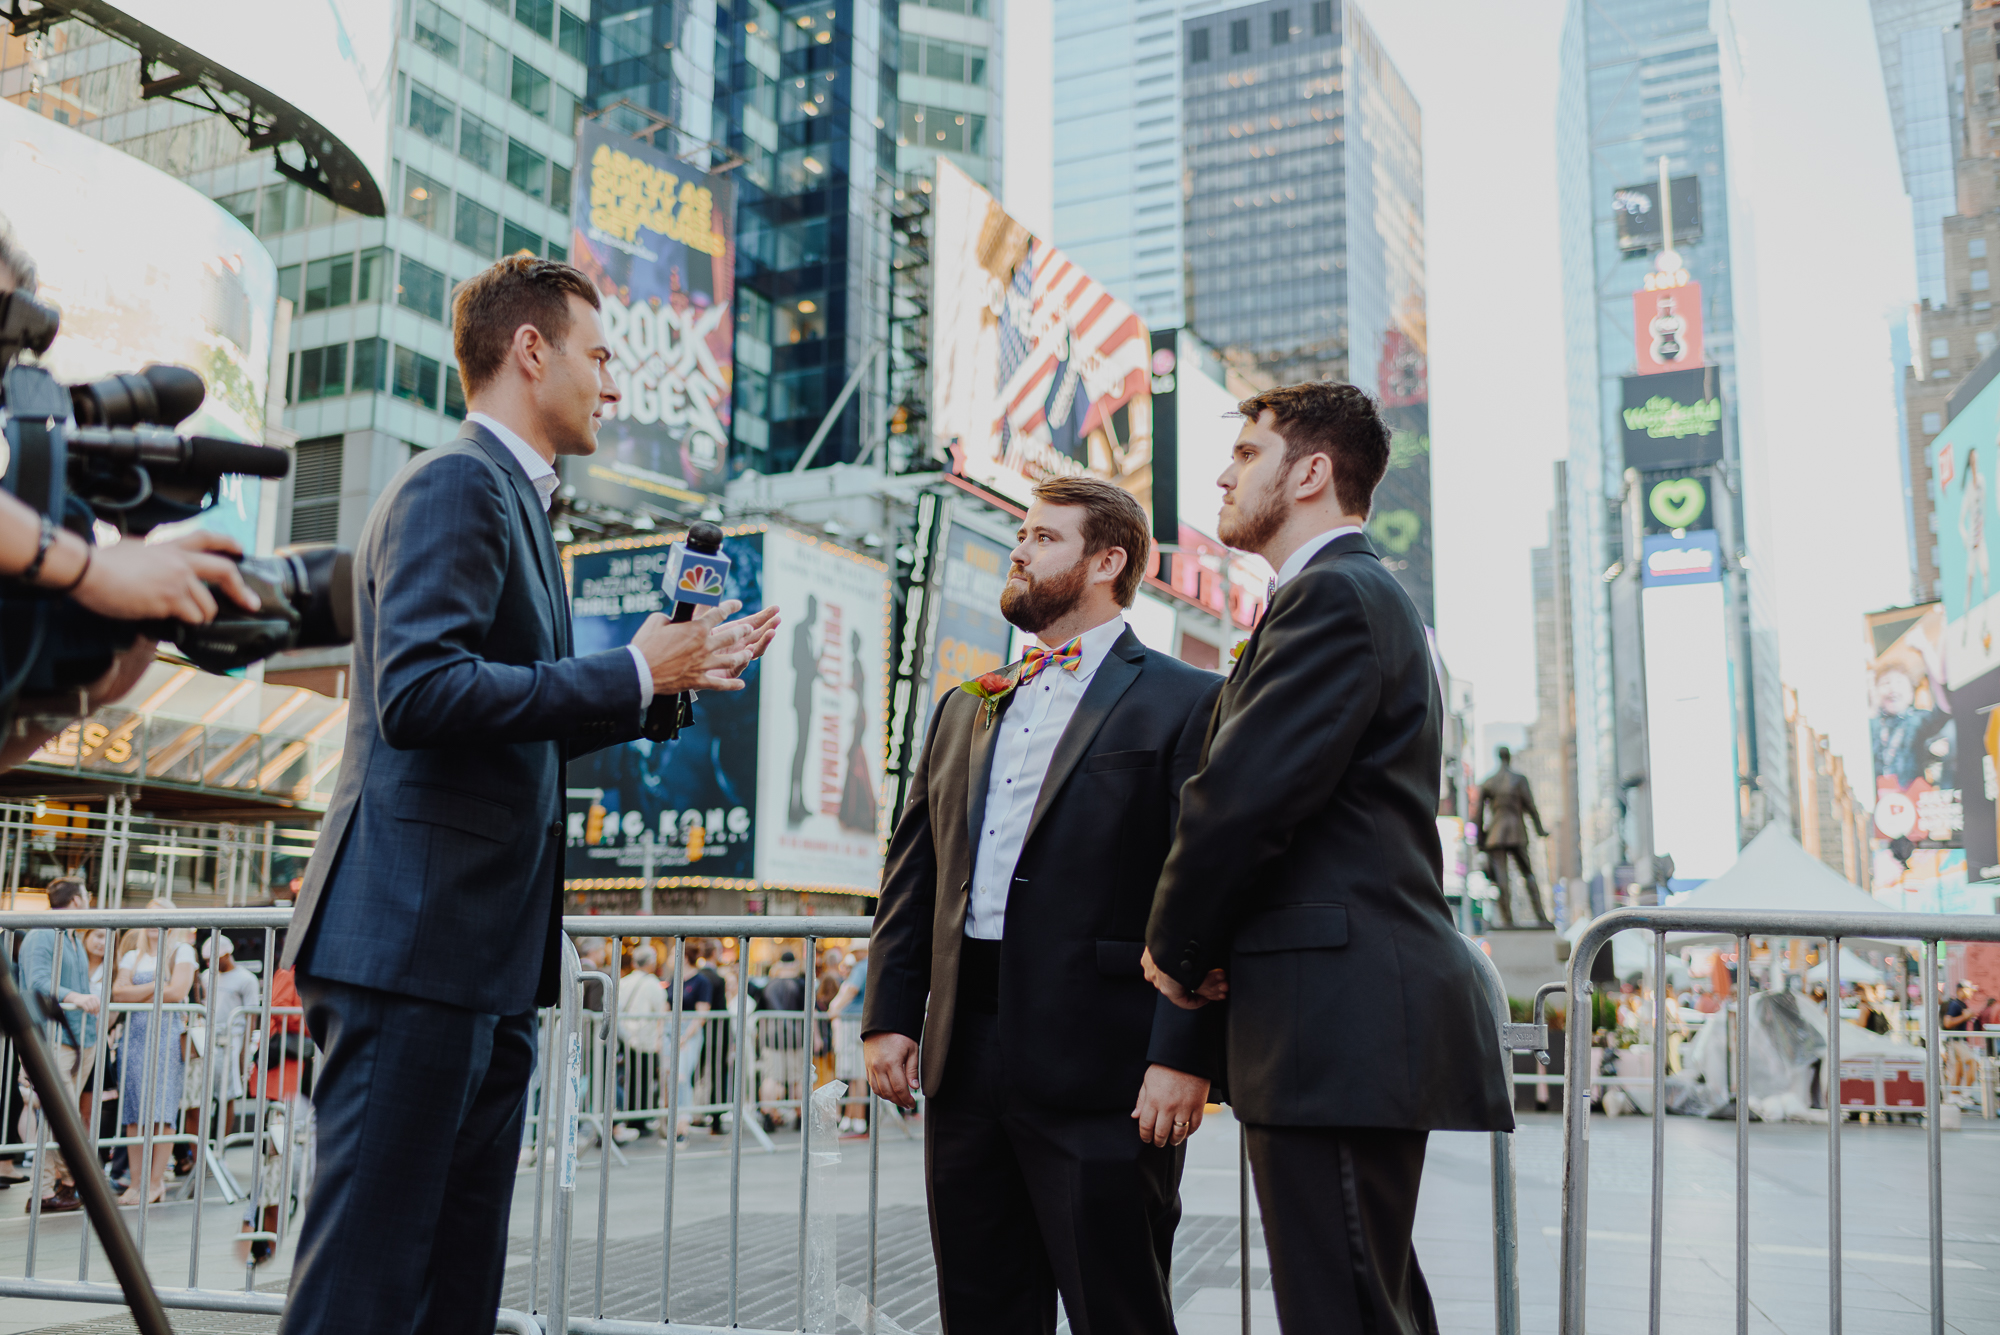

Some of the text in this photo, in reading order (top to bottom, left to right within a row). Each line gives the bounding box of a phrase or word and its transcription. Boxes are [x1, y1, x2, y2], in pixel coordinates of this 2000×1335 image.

[600, 295, 731, 393] ROCK
[820, 715, 842, 816] WOMAN
[567, 810, 645, 838] KNG
